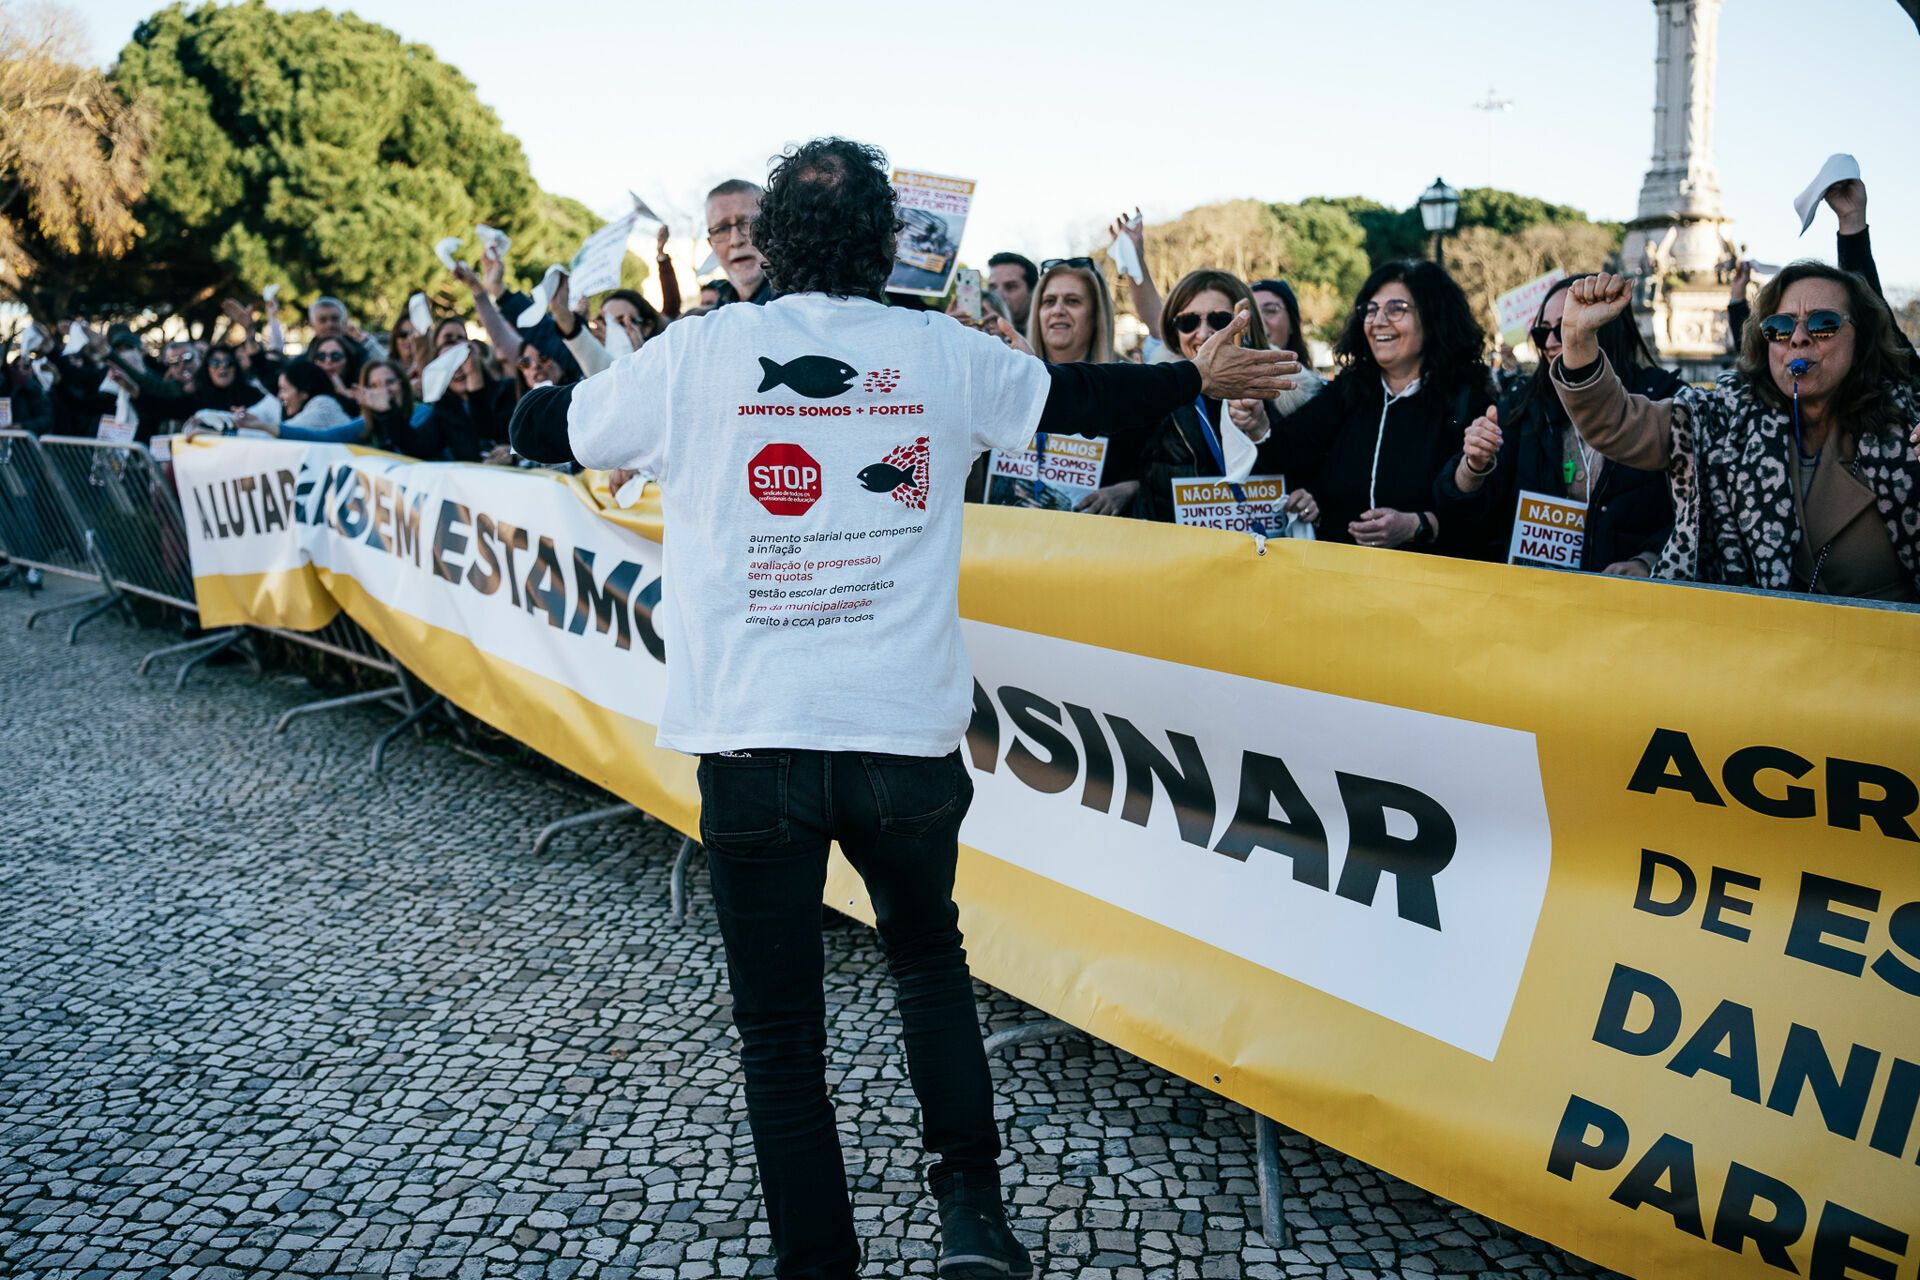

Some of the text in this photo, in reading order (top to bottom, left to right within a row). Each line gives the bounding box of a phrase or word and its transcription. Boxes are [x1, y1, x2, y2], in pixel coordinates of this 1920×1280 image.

[738, 405, 795, 416] JUNTOS
[799, 406, 851, 416] SOMOS
[869, 404, 924, 415] FORTES
[1032, 437, 1097, 457] RAMOS
[996, 461, 1033, 476] MAIS
[997, 451, 1096, 472] TOS SOMOS
[1183, 485, 1277, 501] NÃO PAMOS
[1182, 505, 1232, 518] JUNTOS
[1529, 504, 1563, 523] NÃO
[750, 525, 923, 543] aumento salarial que compense
[1522, 525, 1583, 546] JUNTOS
[748, 544, 802, 556] a inflação
[1520, 539, 1567, 562] MAIS
[750, 555, 881, 572] avaliação (e progressão)
[747, 572, 813, 583] sem quotas
[749, 580, 895, 599] gestão escolar democrática
[749, 603, 767, 612] fim
[785, 599, 873, 612] municipalização
[745, 612, 874, 628] direito à CGA para todos
[1626, 727, 1920, 843] AGR
[1633, 848, 1762, 943] DE
[1591, 962, 1920, 1167] DANI
[1546, 1093, 1920, 1280] PARE
